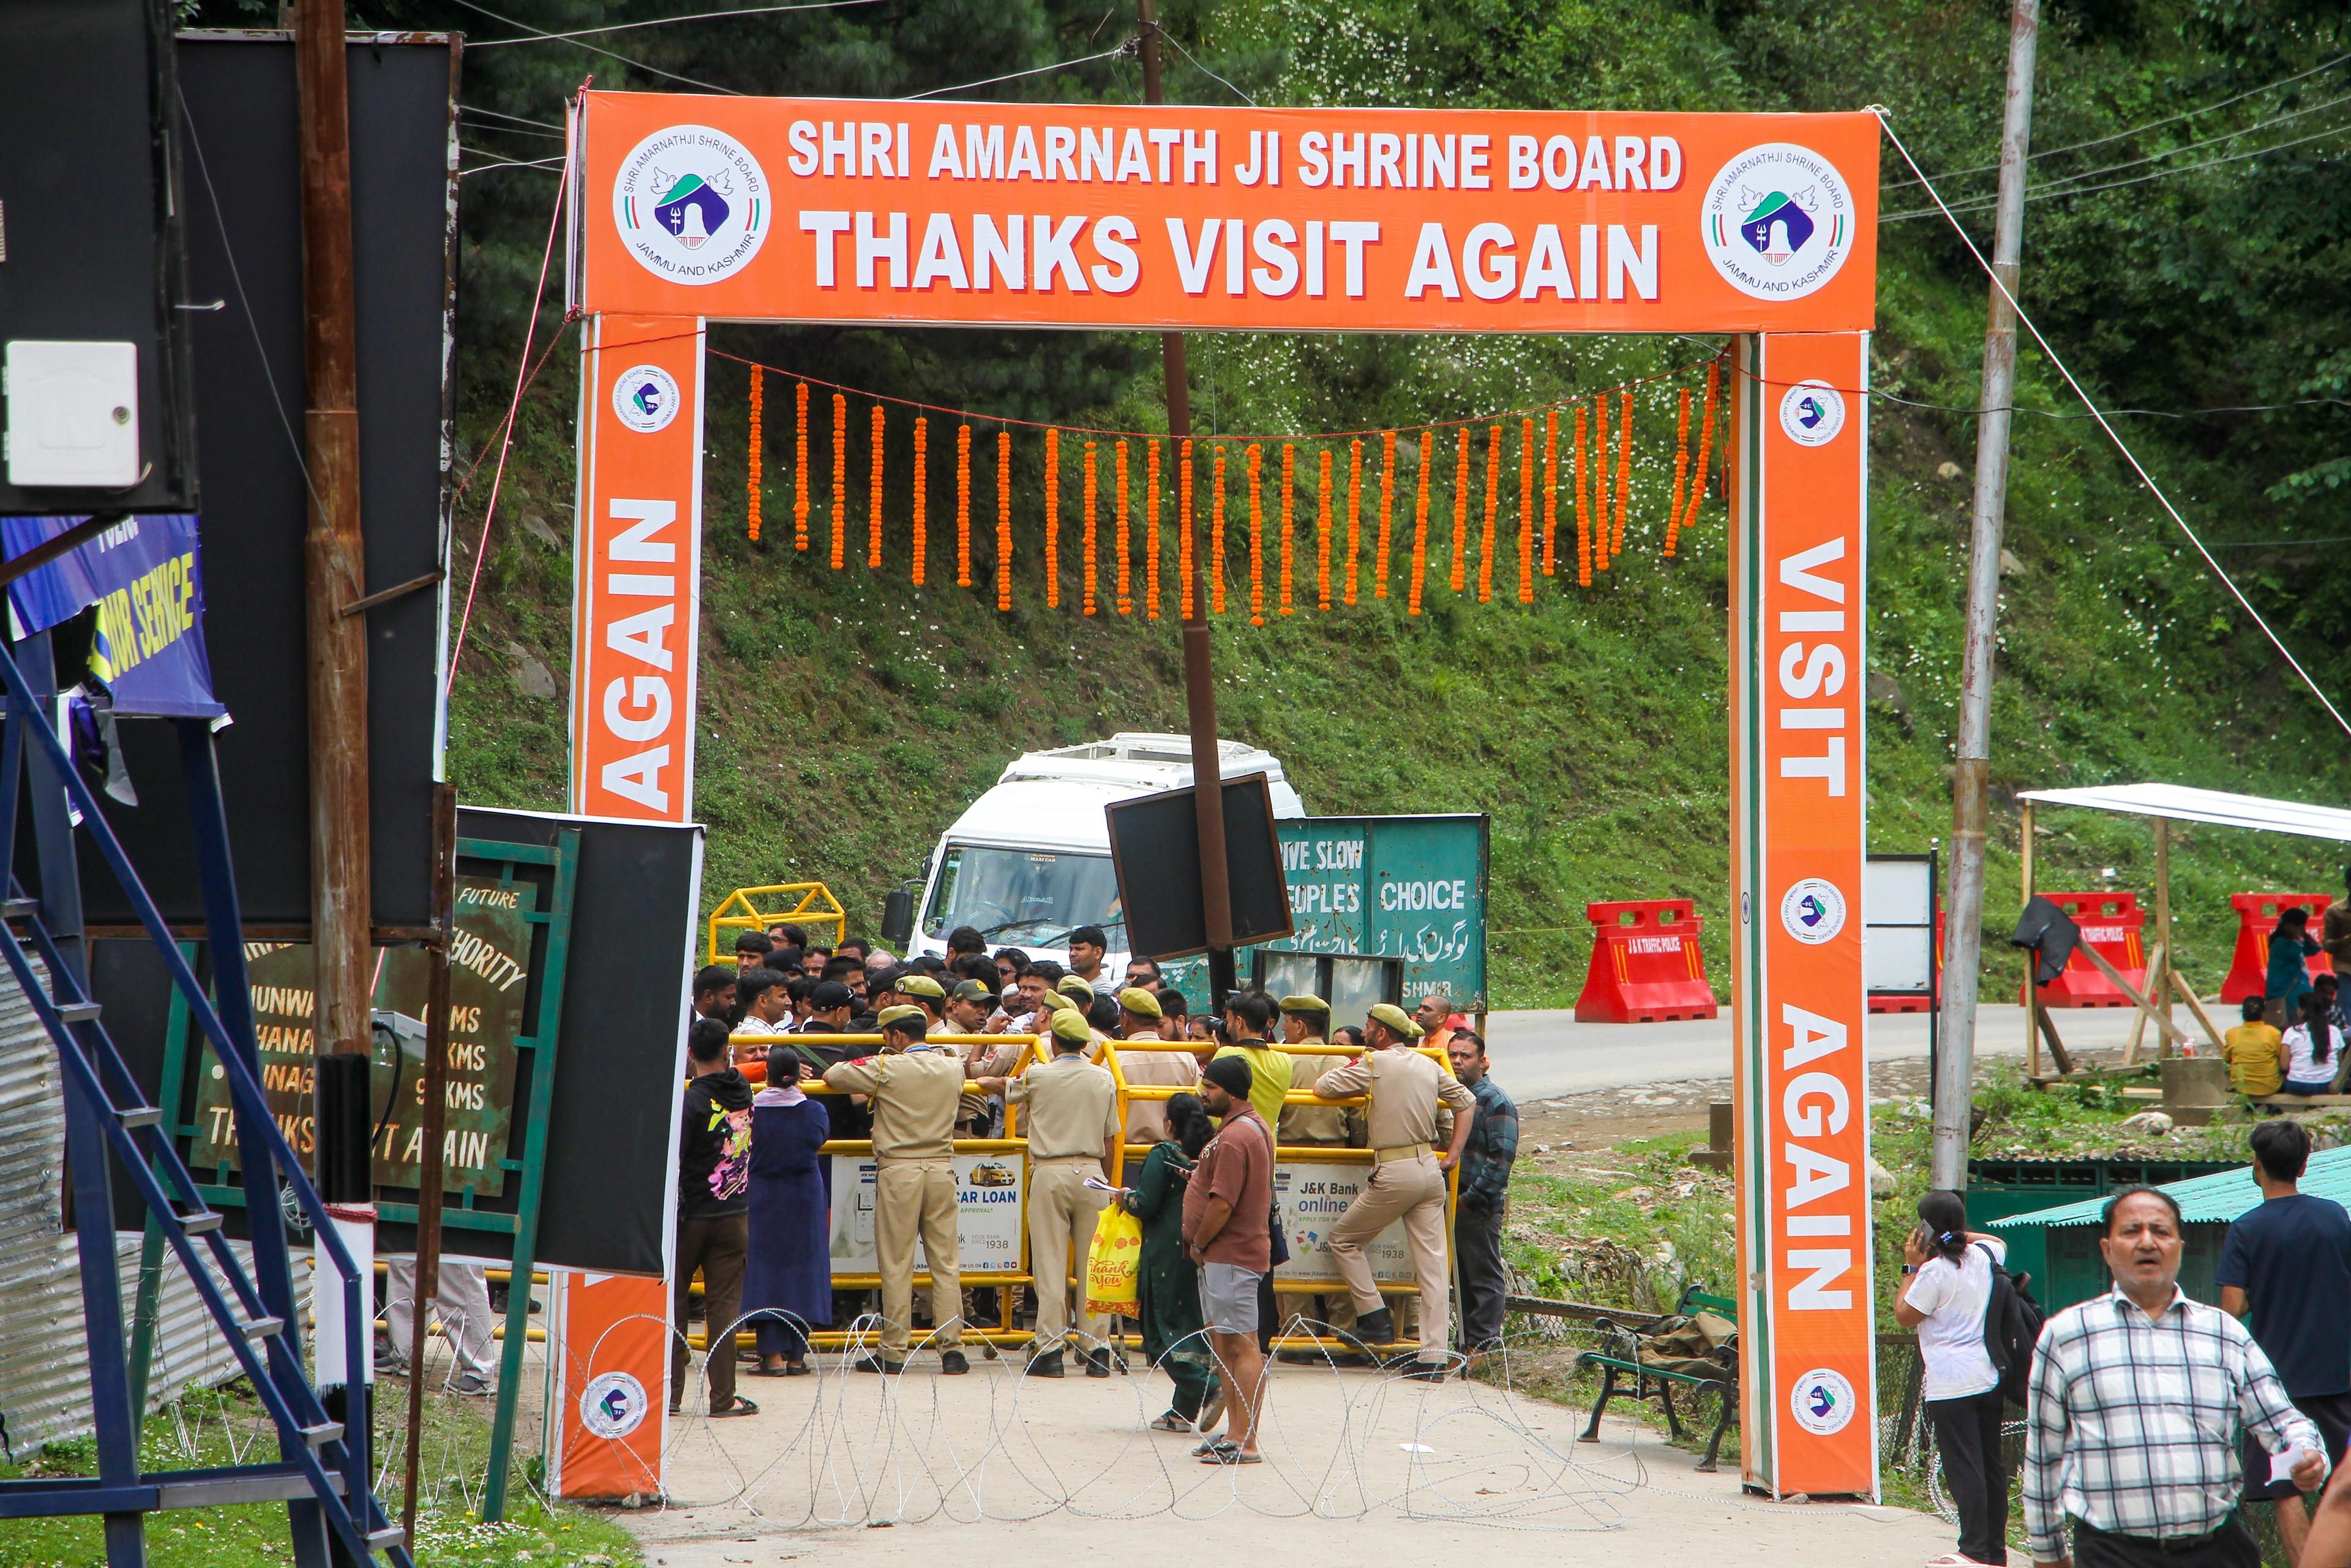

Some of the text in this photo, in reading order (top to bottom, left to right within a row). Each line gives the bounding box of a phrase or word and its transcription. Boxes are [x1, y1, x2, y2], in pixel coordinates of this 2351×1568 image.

[624, 134, 759, 193] SHRI AMARNATHJI SHRINE BOARD
[788, 120, 1681, 190] SHRI AMARNATH JI SHRINE BOARD
[1712, 152, 1843, 211] SHRI AMARNATHJI SHRINE BOARD
[636, 234, 755, 276] JAMMU AND KASHMIR
[799, 210, 1657, 300] THANKS VISIT AGAIN
[1723, 249, 1838, 291] JAMMU AND KASHMIR
[131, 552, 194, 660] SERVICE
[602, 498, 677, 814] AGAIN
[1779, 536, 1846, 797] VISIT
[1316, 840, 1364, 870] SLOW
[458, 888, 520, 910] FUTURE
[1381, 880, 1466, 911] CHOICE
[1641, 937, 1662, 953] TRAFFIC
[1661, 936, 1681, 952] POLICE
[1401, 981, 1453, 998] SHMIR
[449, 1005, 481, 1033] MS
[446, 1081, 485, 1111] KMS
[402, 1127, 489, 1171] AAIN
[1782, 1002, 1852, 1310] AGAIN
[982, 1191, 1017, 1203] LOAN
[1300, 1182, 1359, 1195] J&K Bank
[1299, 1196, 1348, 1212] online
[986, 1240, 1008, 1249] 1938
[1382, 1250, 1404, 1259] 1938
[1088, 1257, 1133, 1278] Thank
